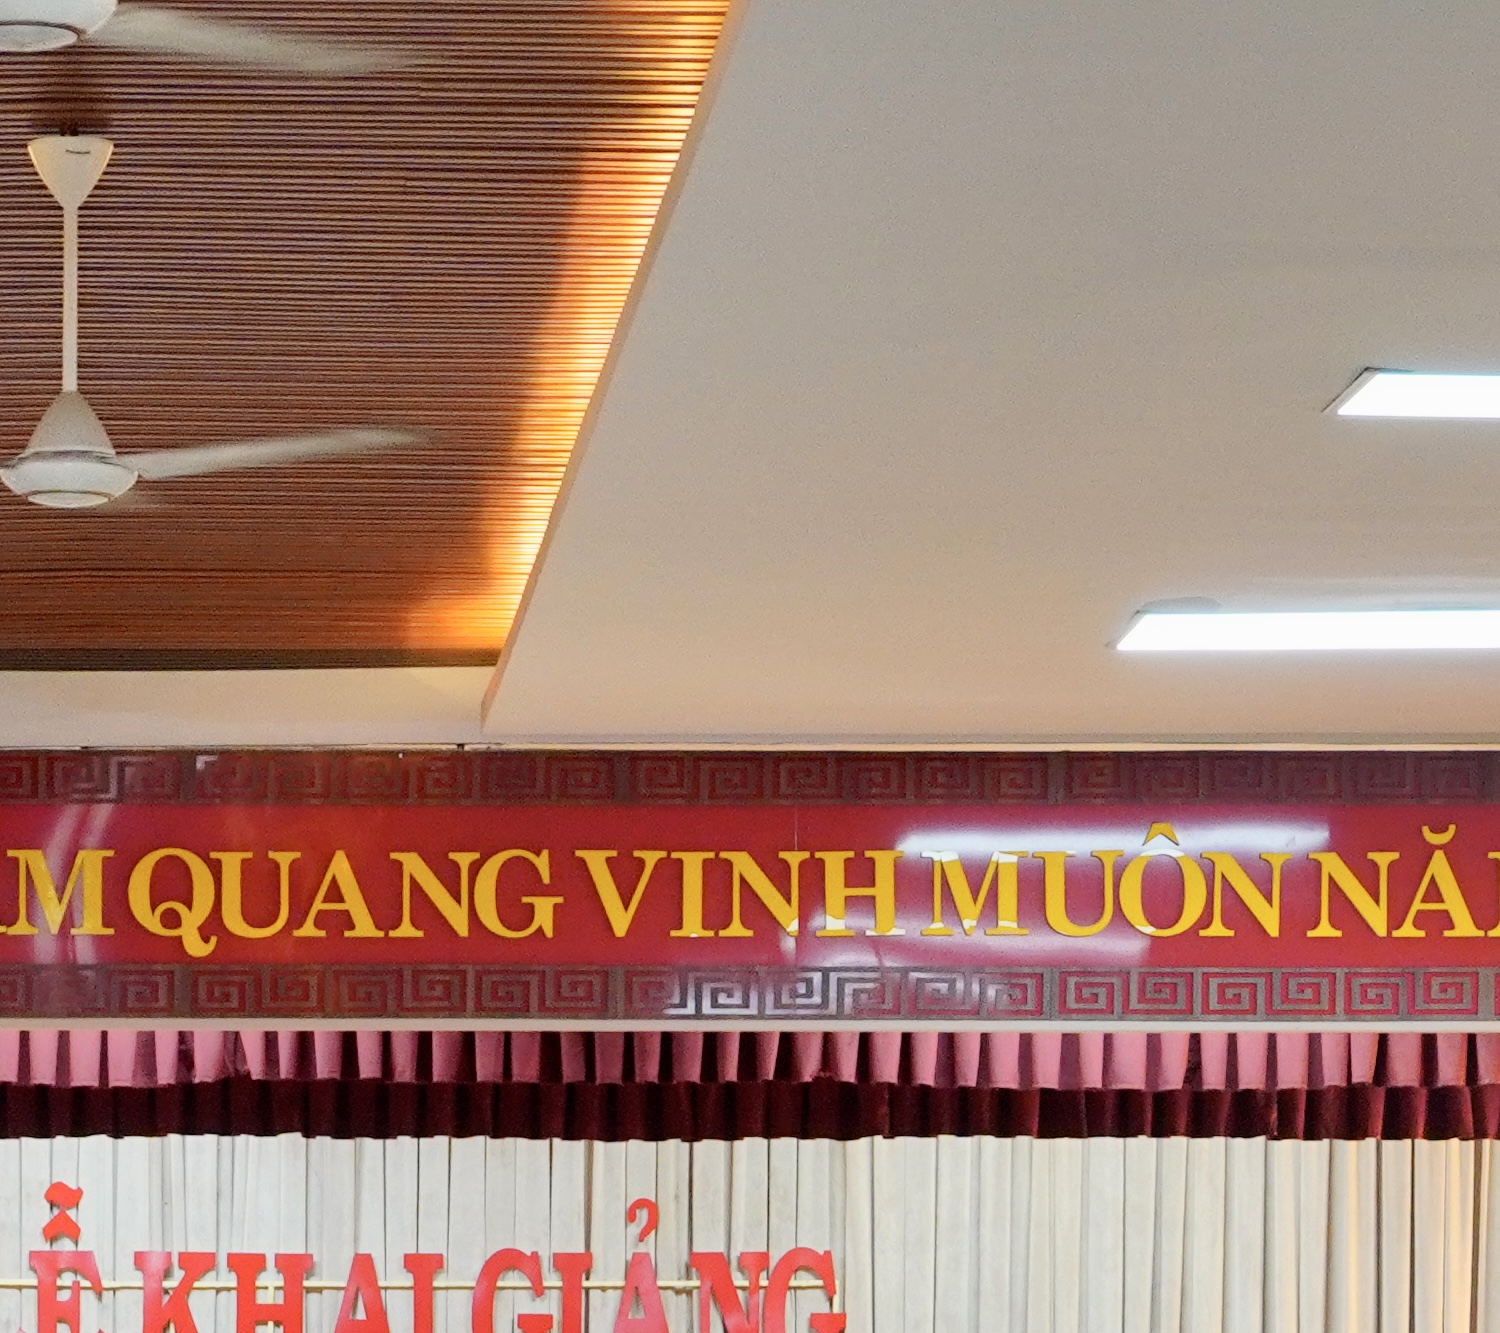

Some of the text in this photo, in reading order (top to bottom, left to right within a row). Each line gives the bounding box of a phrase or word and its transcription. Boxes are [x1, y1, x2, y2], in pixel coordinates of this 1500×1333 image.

[127, 846, 565, 956] QUANG
[592, 848, 897, 940] VINH
[922, 821, 1291, 940] MUÔN
